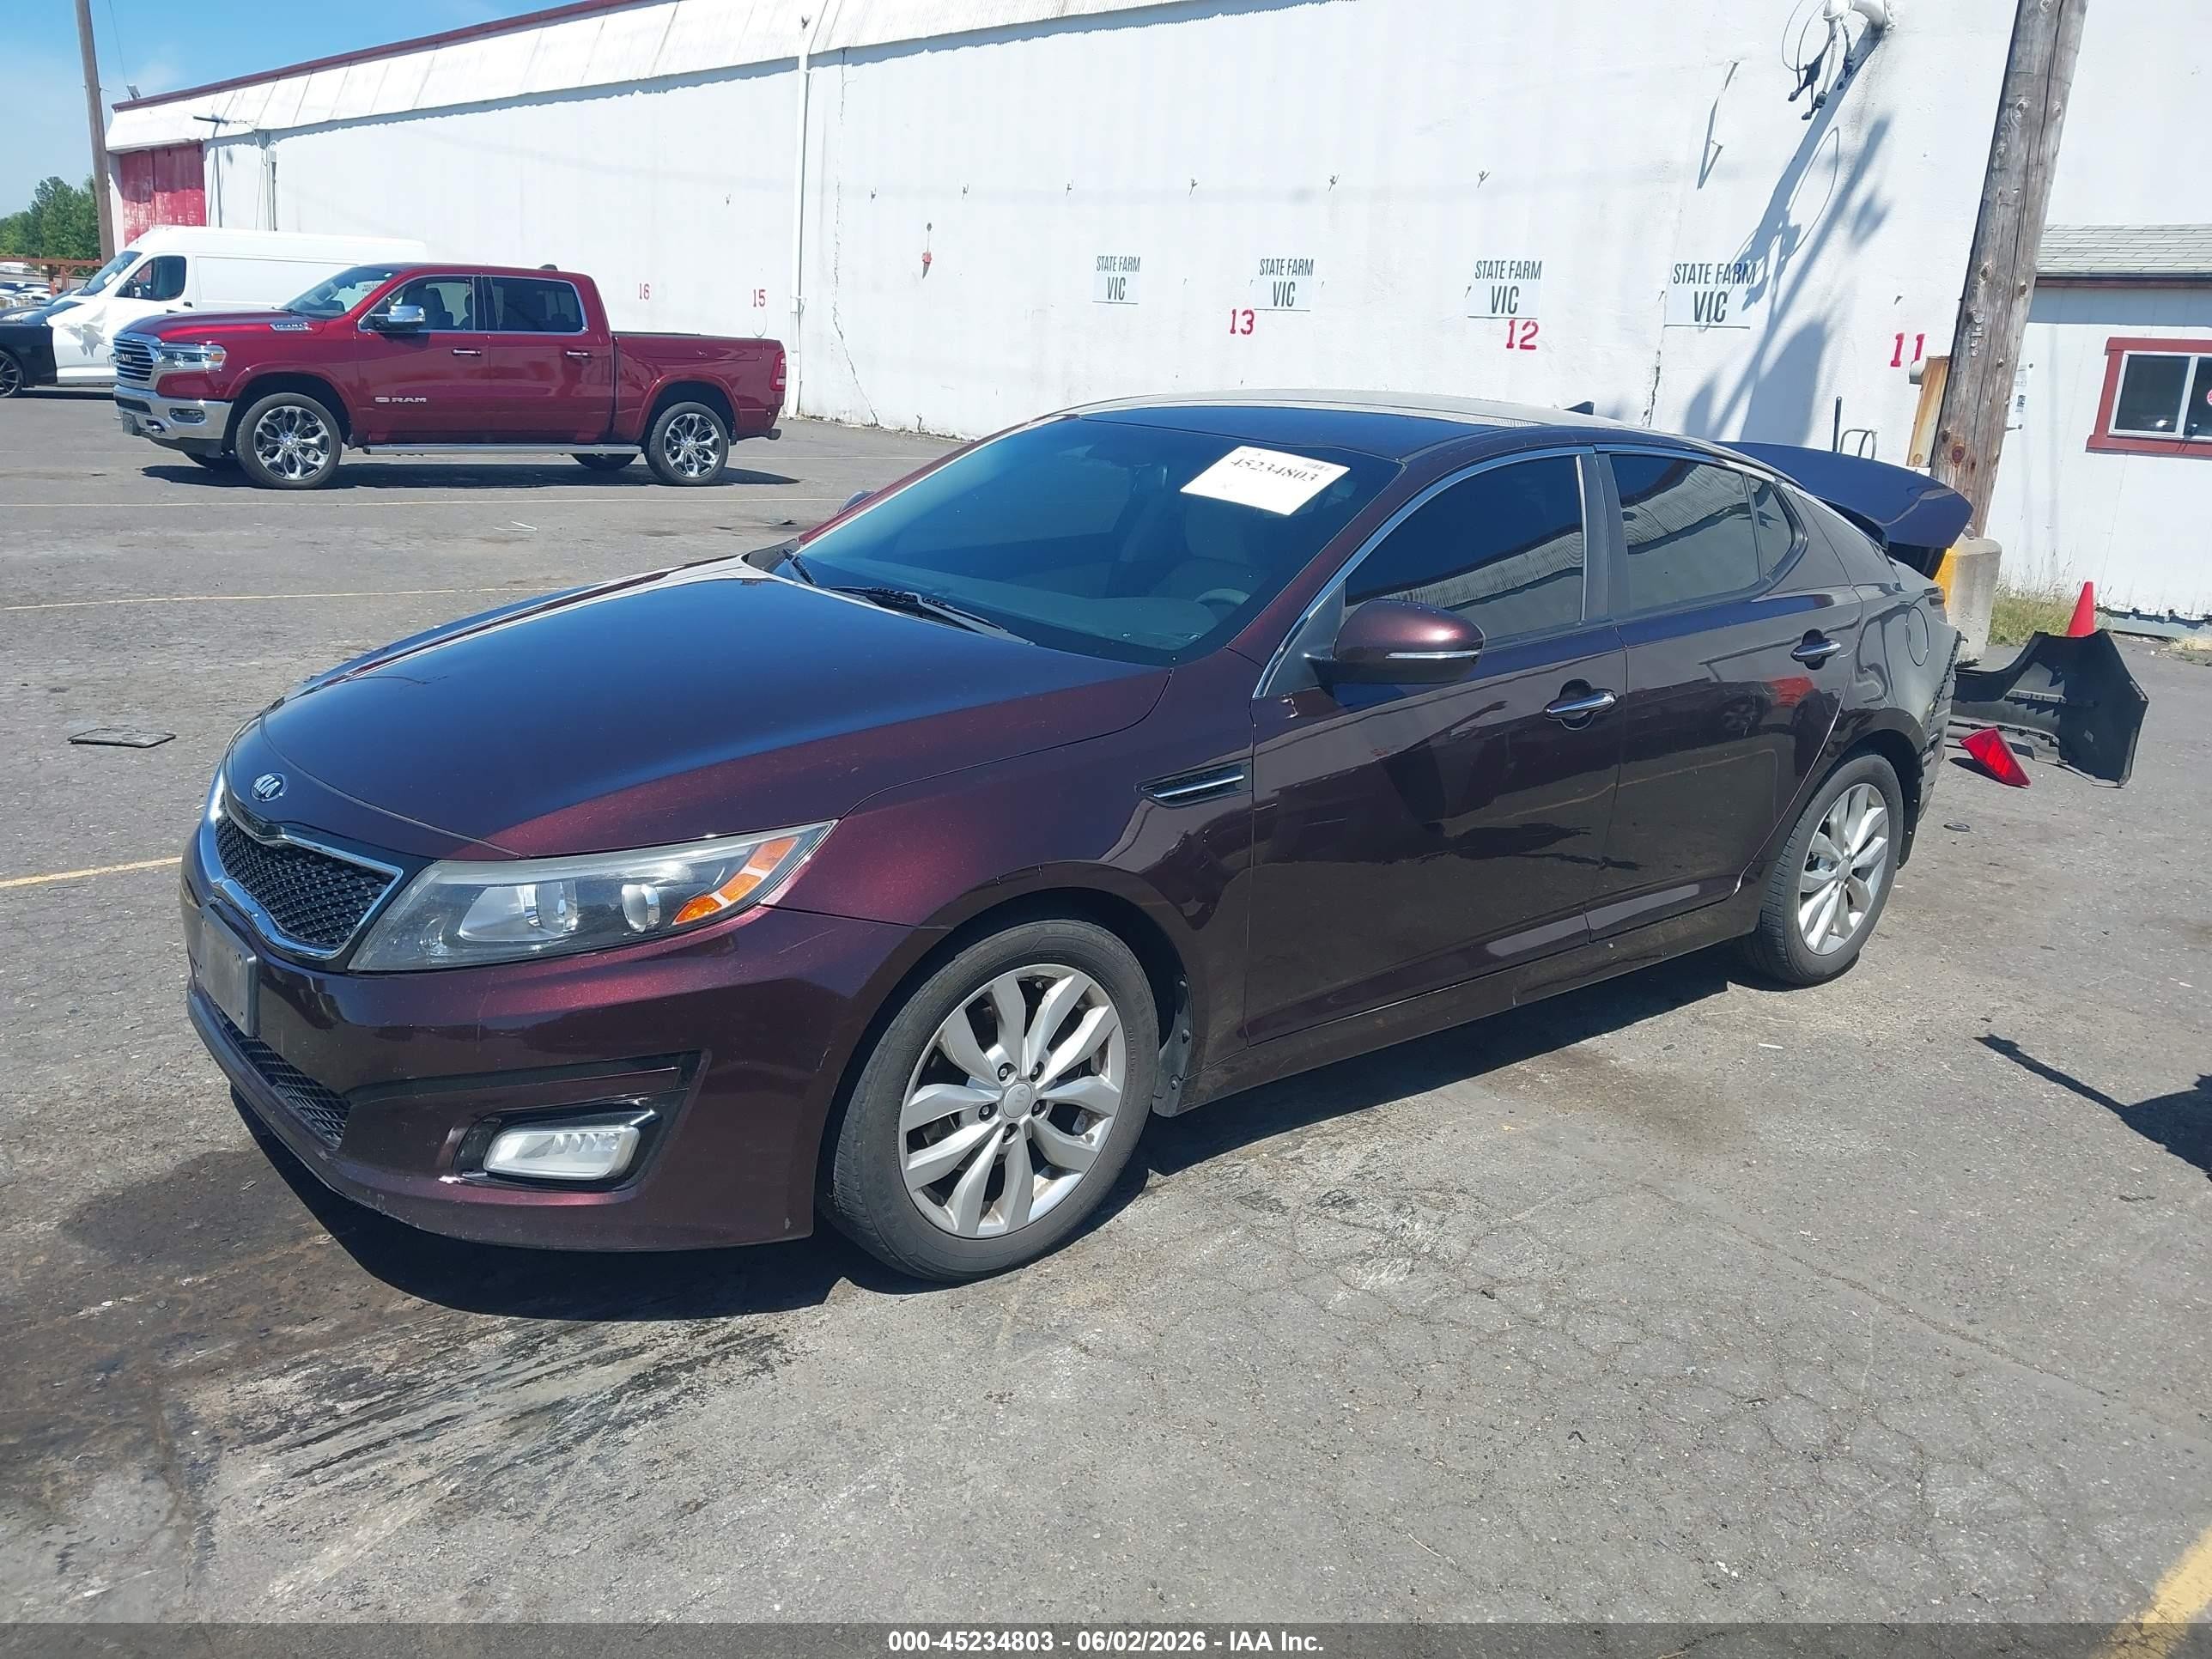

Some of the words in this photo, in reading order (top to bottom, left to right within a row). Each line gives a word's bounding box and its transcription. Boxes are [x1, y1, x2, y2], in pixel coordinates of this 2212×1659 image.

[1097, 256, 1117, 272] STATE
[1118, 257, 1140, 273] FARM
[1259, 258, 1285, 276] STATE
[1287, 258, 1314, 276] FARM
[1474, 260, 1506, 280] STATE
[1508, 260, 1542, 281] FARM
[1673, 263, 1712, 284] STATE
[1714, 263, 1758, 285] FARM
[639, 283, 650, 300] 16
[752, 289, 767, 307] 15
[1107, 276, 1126, 301] VIC
[1273, 281, 1296, 307] VIC
[1491, 285, 1519, 314] VIC
[1693, 290, 1729, 323] VIC
[1230, 308, 1255, 335] 13
[1506, 319, 1540, 350] 12
[1890, 332, 1925, 368] 11
[1231, 459, 1319, 482] 45234803
